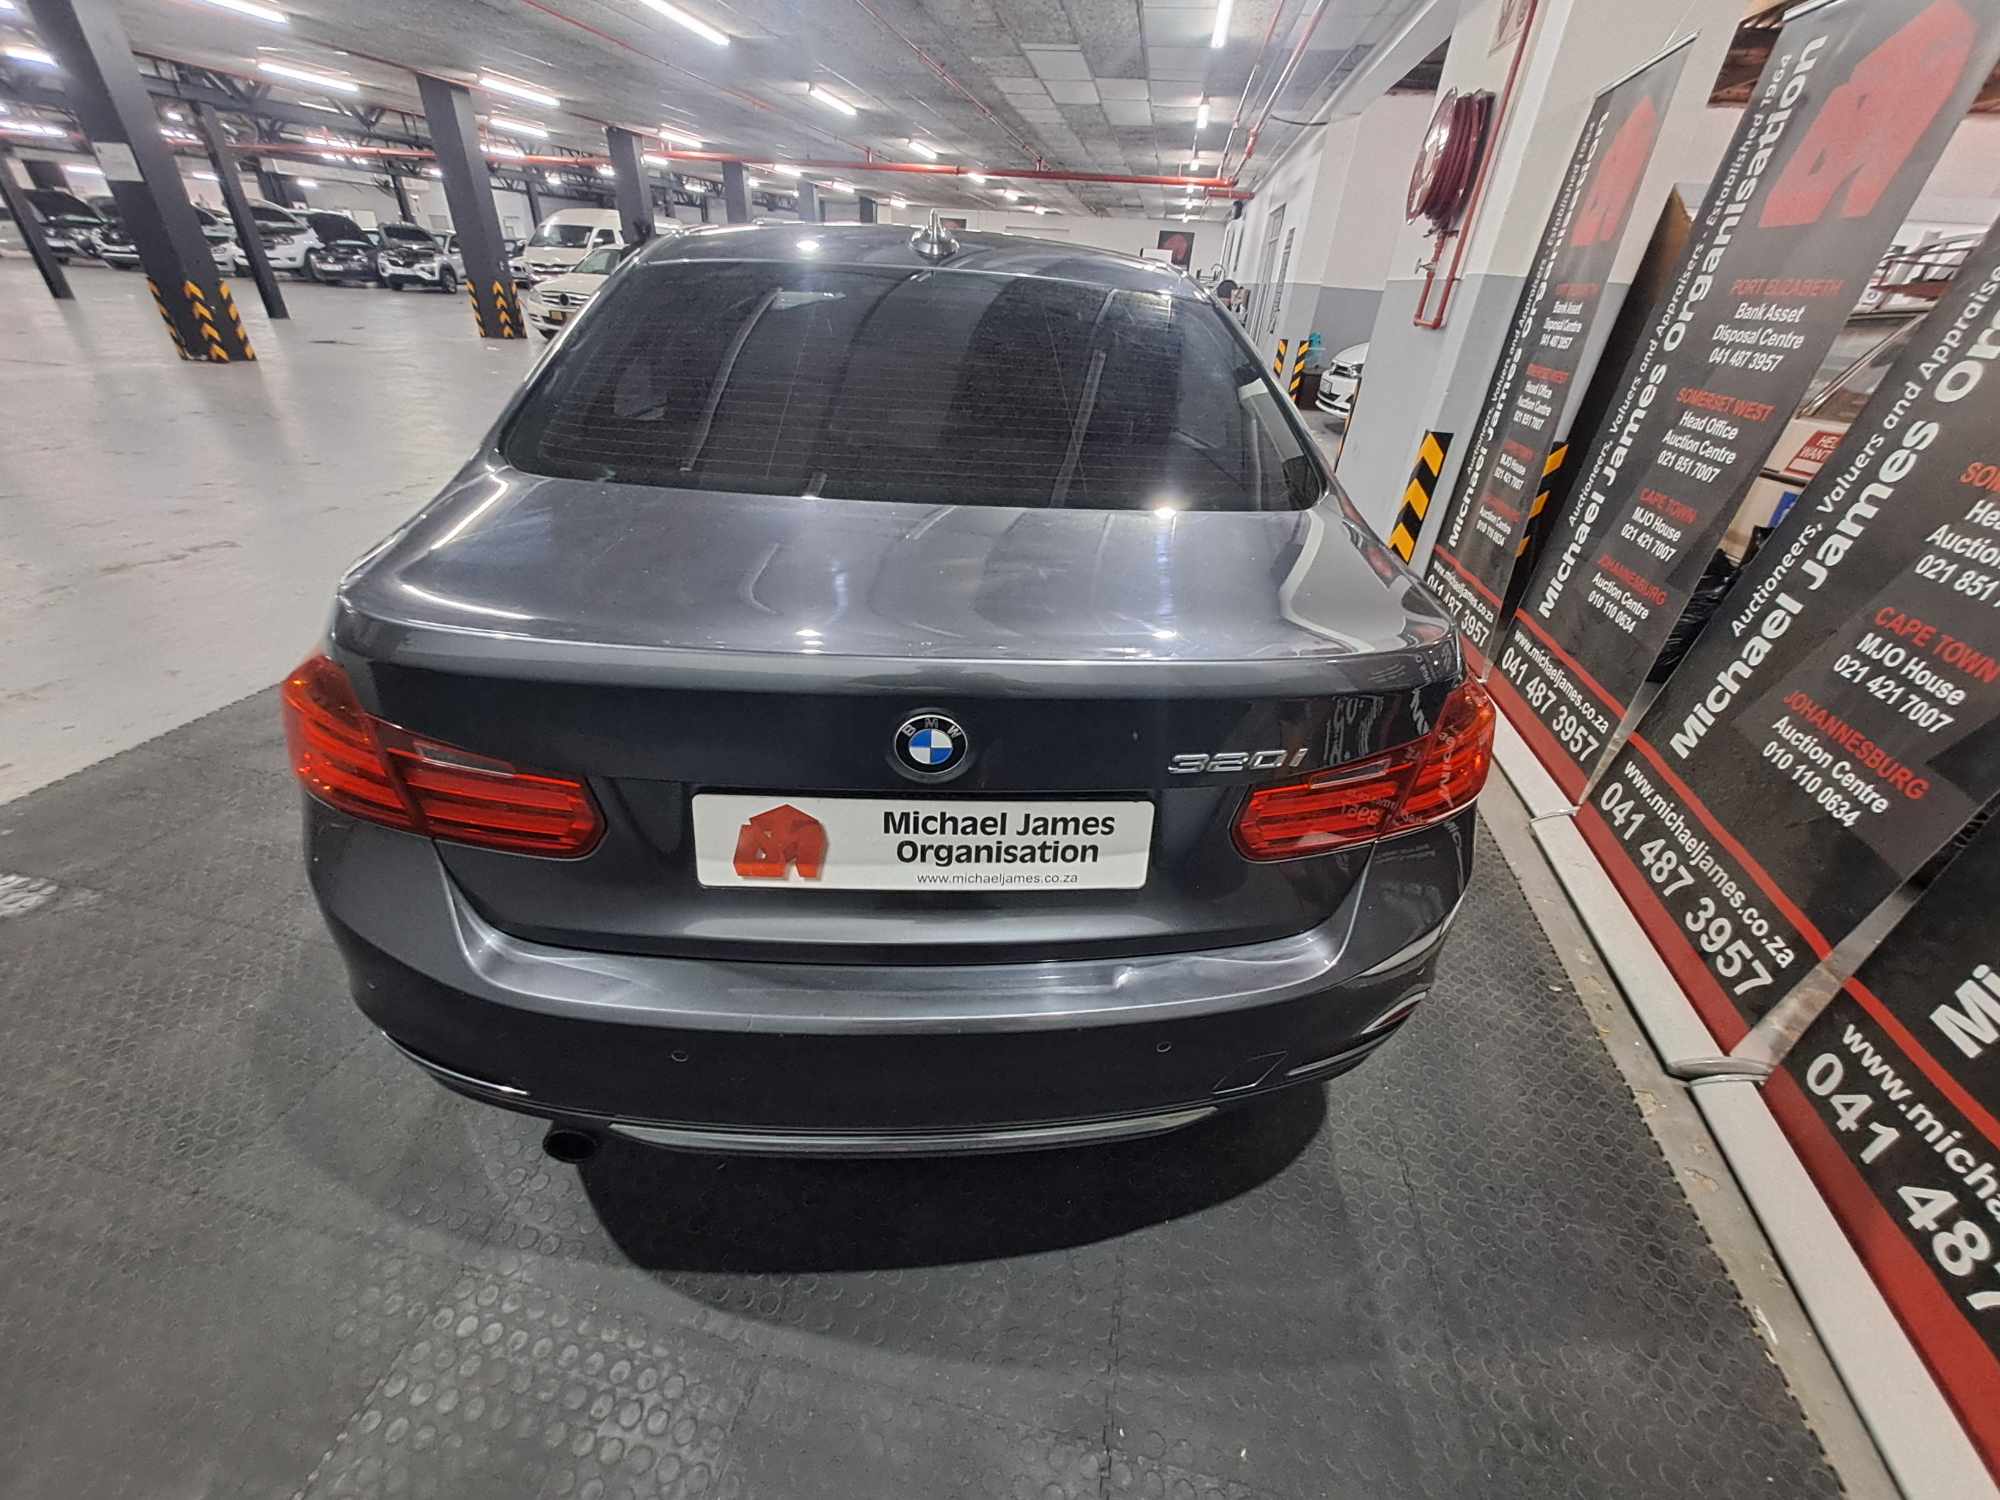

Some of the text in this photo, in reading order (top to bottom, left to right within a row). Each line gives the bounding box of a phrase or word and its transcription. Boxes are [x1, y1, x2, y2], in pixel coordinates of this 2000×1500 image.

[1609, 376, 1642, 434] Valuers
[1639, 339, 1659, 373] and
[1655, 242, 1704, 339] Appraisers
[1706, 113, 1764, 227] Established
[1759, 53, 1793, 109] 1964
[1537, 35, 1829, 619] Michael James Organisation
[1734, 302, 1807, 323] Bank Asset
[1708, 346, 1784, 373] 041 487 3957
[1712, 324, 1805, 350] Disposal Centre
[1448, 446, 1488, 548] Michael
[1487, 348, 1522, 441] James
[1662, 429, 1737, 465] Auction Centre
[1678, 410, 1740, 441] Head Office
[1657, 449, 1723, 484] 021 851 7007
[1632, 506, 1682, 542] MJO House
[1731, 521, 1824, 637] Auctioneers,
[1816, 434, 1884, 513] Valuers
[1883, 381, 1922, 430] and
[1620, 523, 1678, 562] 021 421 7007
[1592, 572, 1649, 620] Auction Centre
[1670, 592, 1804, 759] Michael
[1801, 420, 1939, 590] James
[1914, 554, 2000, 601] 021 851
[1461, 609, 1490, 648] 3957
[1588, 590, 1637, 634] 010 110 0634
[1856, 632, 1966, 706] MJO House
[1875, 607, 2000, 684] CAPE TOWN
[1501, 647, 1600, 762] 041 487 3957
[1514, 629, 1609, 734] www.michaeljames.co.za
[1833, 654, 1955, 733] 021 421 7007
[902, 718, 963, 738] BMW
[1783, 690, 1931, 800] JOHANNESBURG
[1168, 748, 1308, 774] 320i
[1762, 741, 1861, 827] 010 110 0634
[1772, 715, 1889, 813] Auction Centre
[883, 811, 1116, 837] Michael James
[896, 840, 1099, 867] Organisation
[1624, 761, 1795, 969] www.michaeljames.co.za
[916, 873, 1078, 886] www.michaeljames.co.za
[1600, 782, 1774, 996] 041 487 3957
[1806, 1052, 1900, 1164] 041
